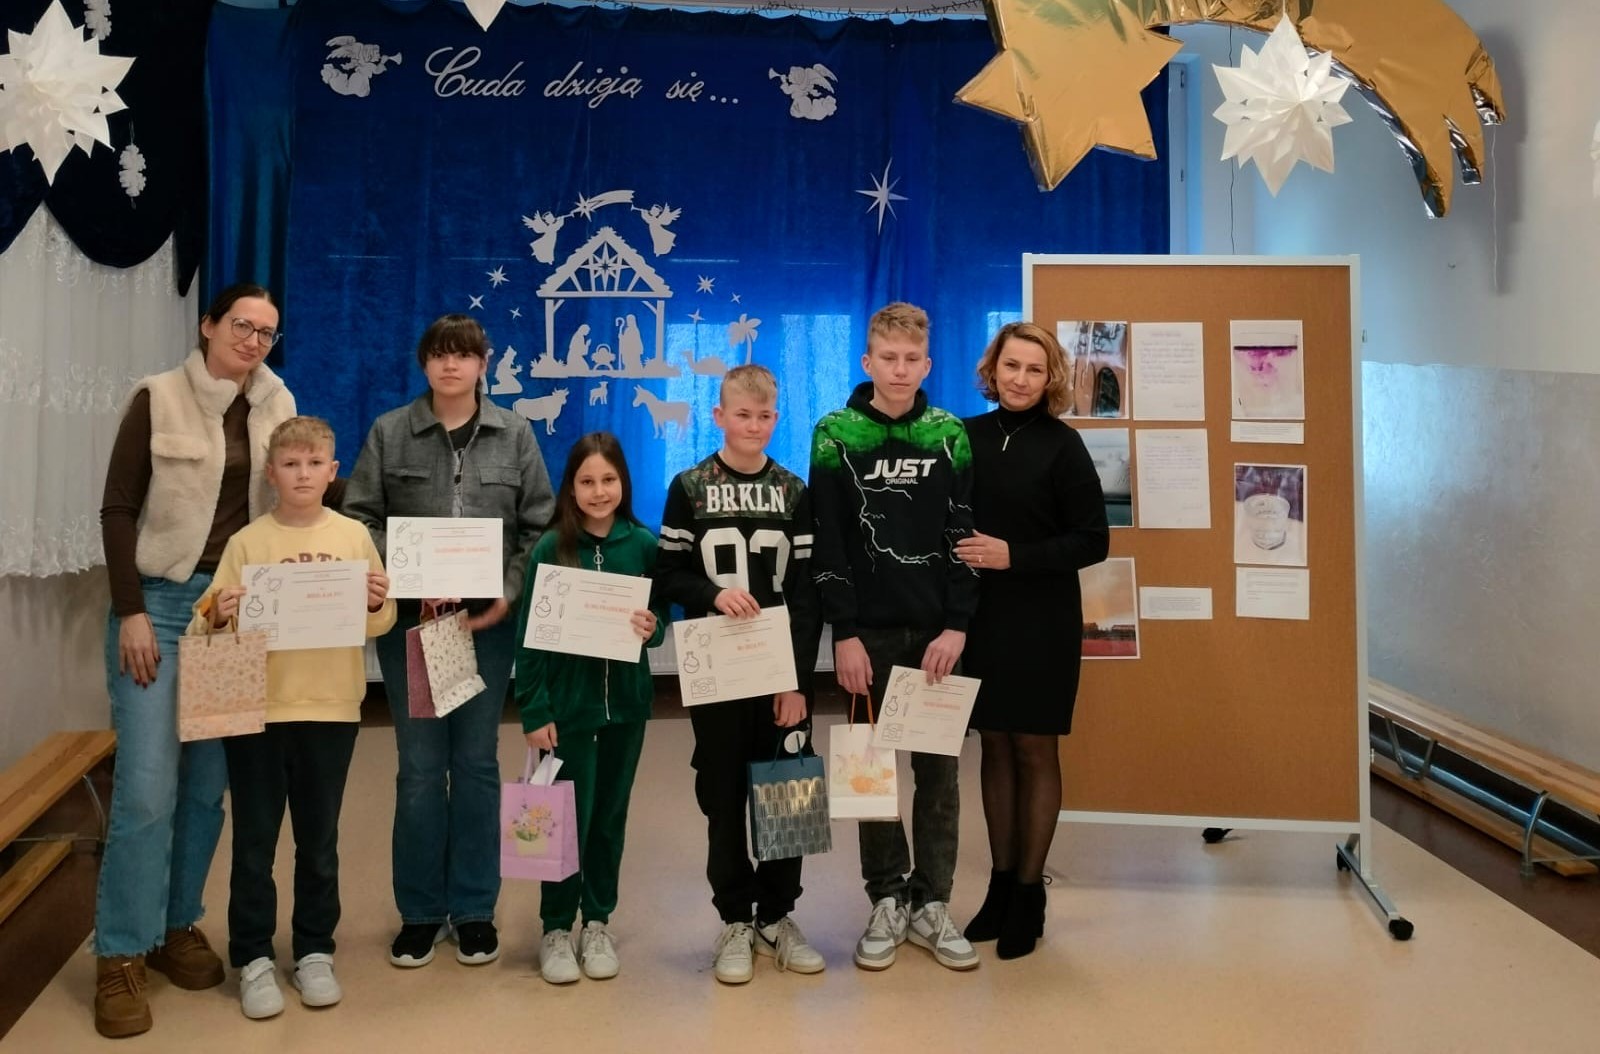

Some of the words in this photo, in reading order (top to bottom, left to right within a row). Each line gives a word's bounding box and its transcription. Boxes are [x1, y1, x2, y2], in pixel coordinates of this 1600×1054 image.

[425, 46, 526, 97] Cuda
[544, 61, 643, 108] dzieją
[863, 459, 937, 480] JUST
[706, 483, 785, 513] BRKLN
